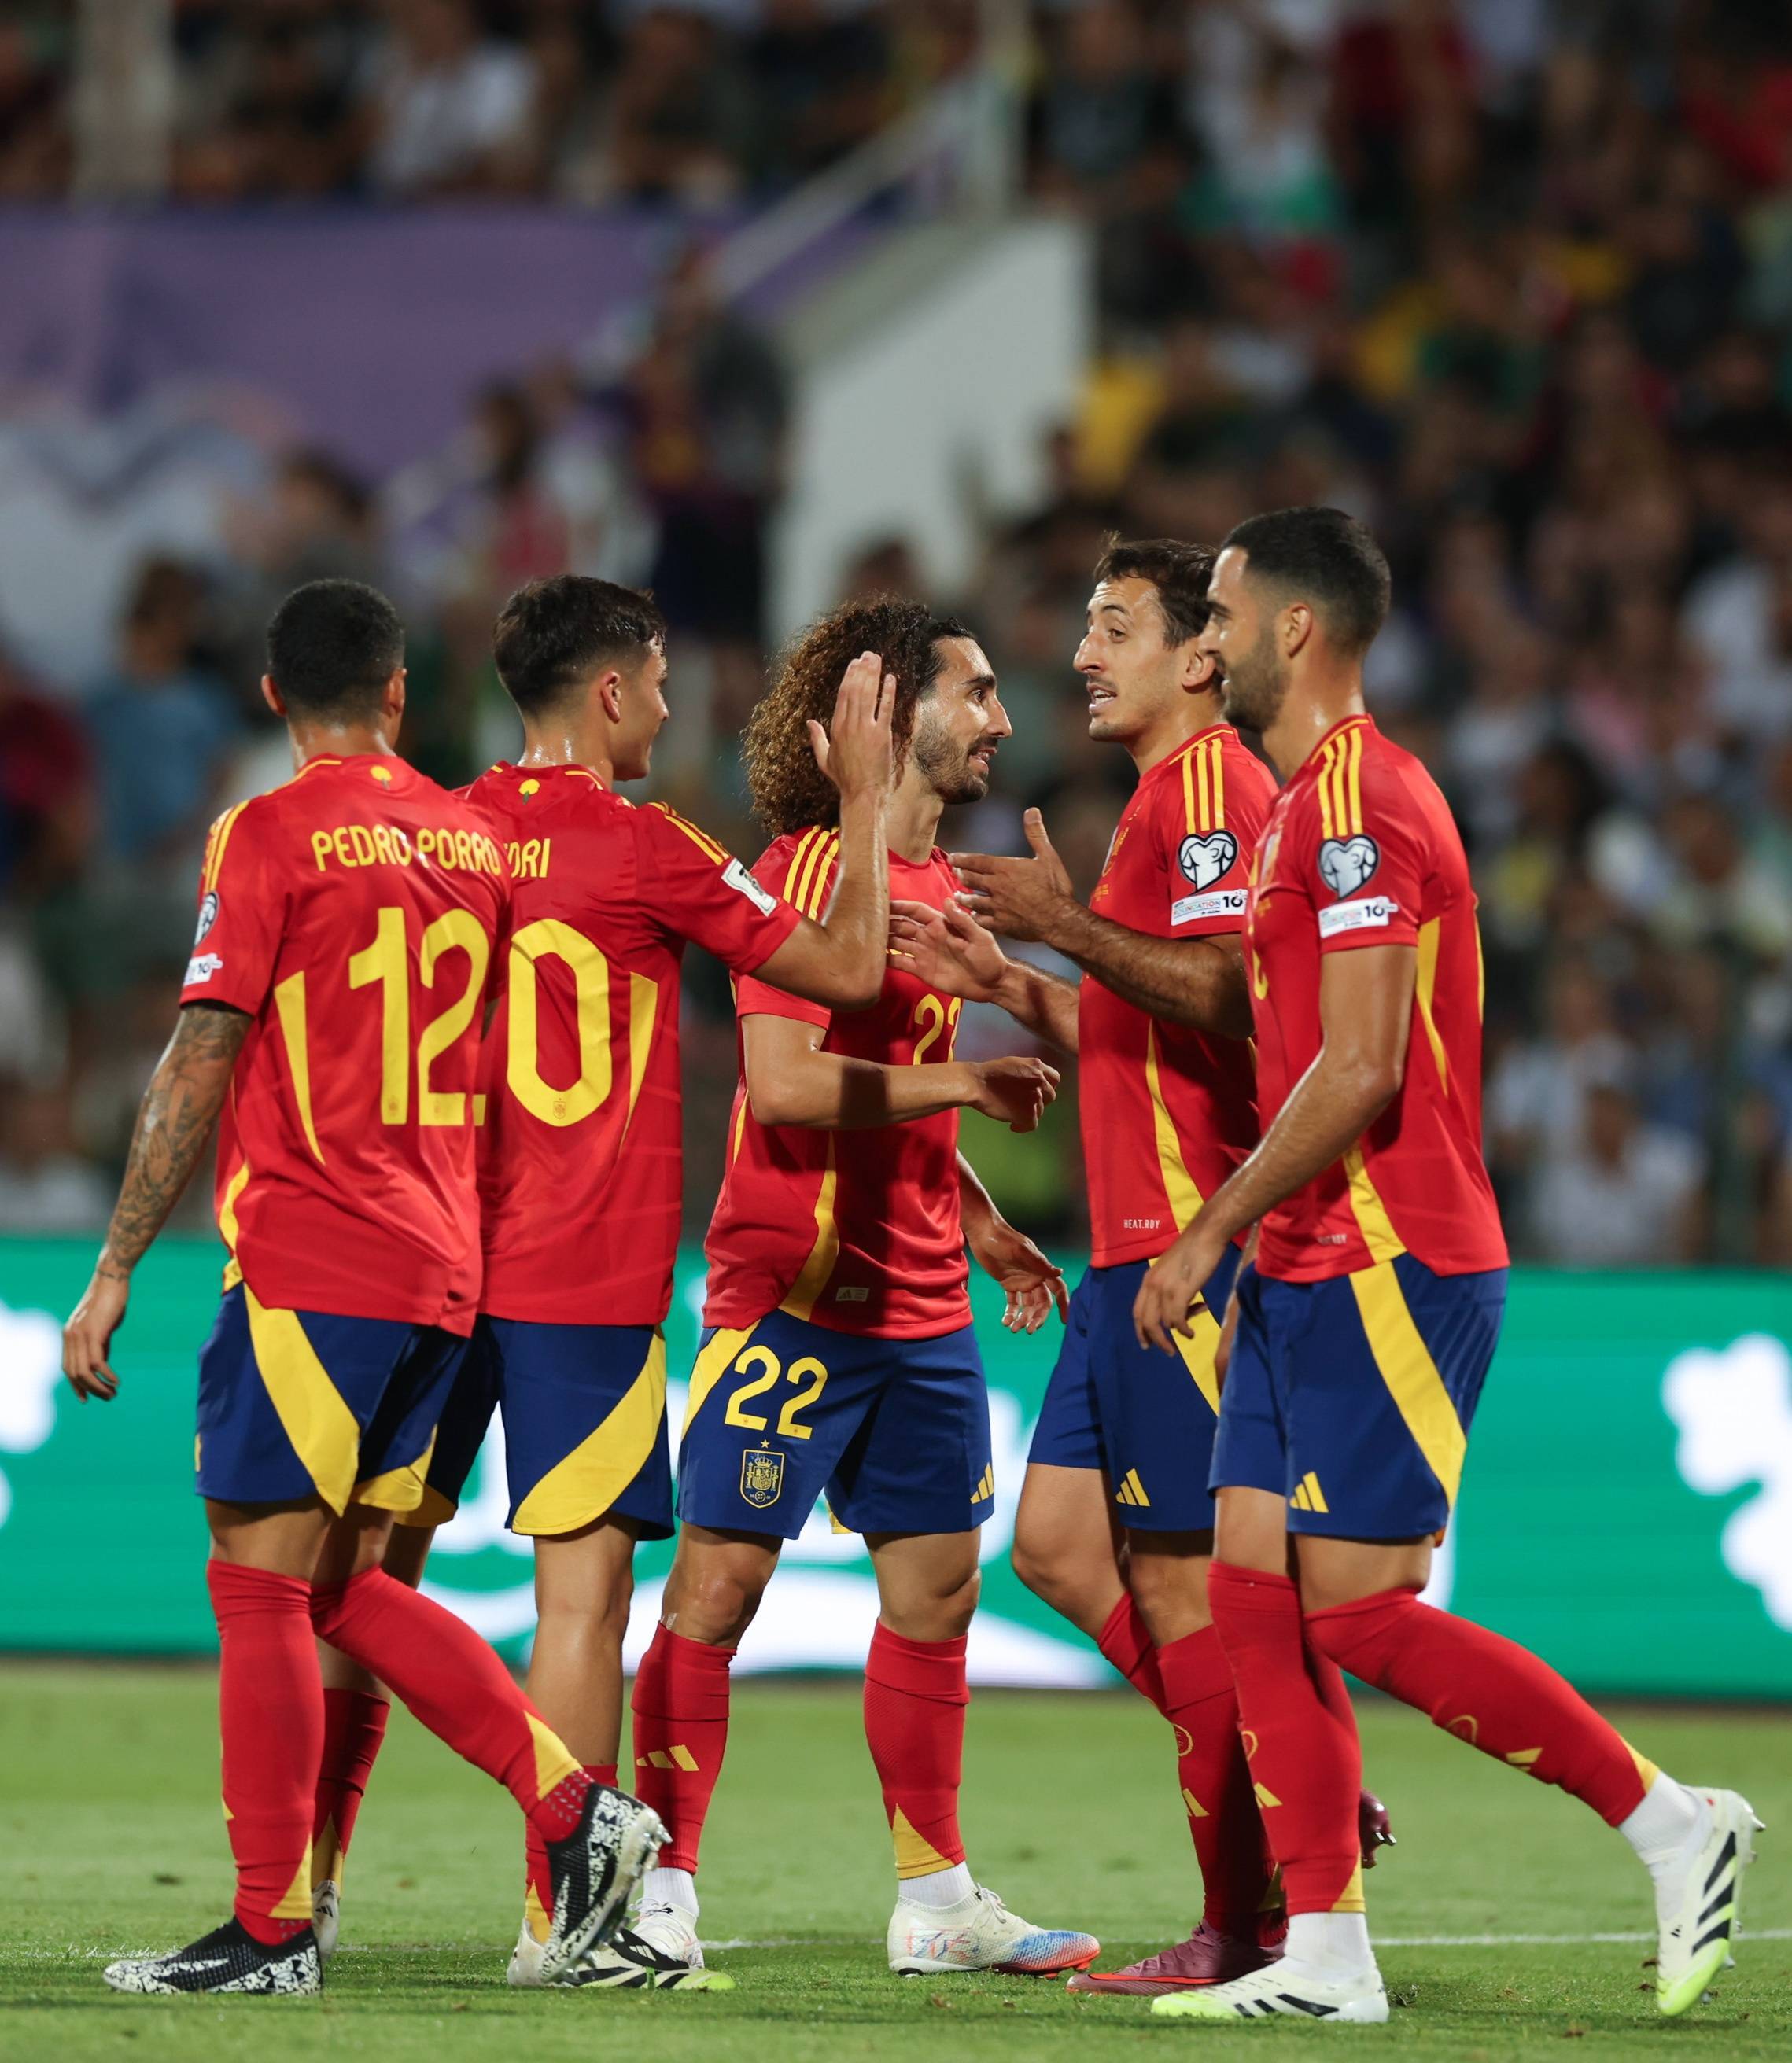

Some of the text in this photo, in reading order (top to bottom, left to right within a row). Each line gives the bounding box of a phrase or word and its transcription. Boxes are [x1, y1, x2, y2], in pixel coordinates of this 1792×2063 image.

[311, 824, 502, 875] PEDRO PORRO
[504, 838, 551, 878] DRI
[1222, 895, 1243, 908] 10
[1365, 905, 1385, 918] 10
[349, 907, 489, 1125] 12
[473, 919, 612, 1126] 0
[725, 1345, 828, 1439] 22
